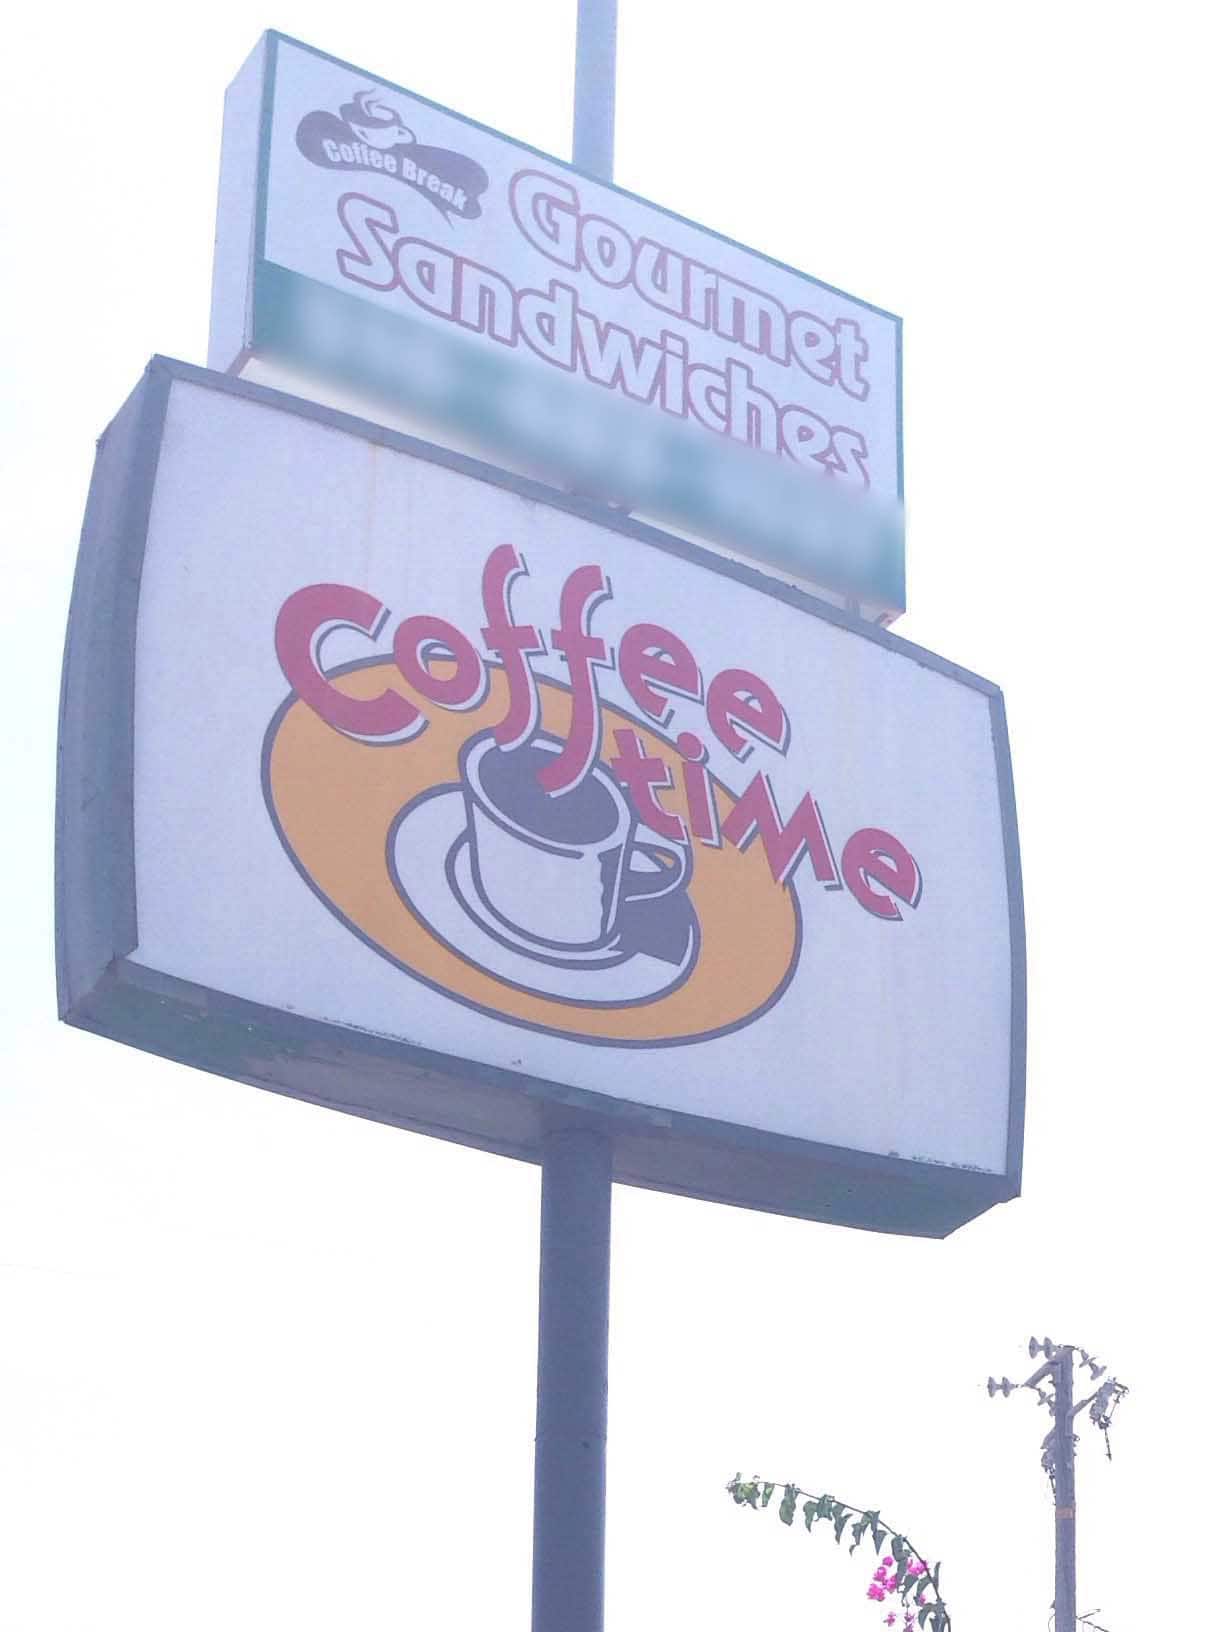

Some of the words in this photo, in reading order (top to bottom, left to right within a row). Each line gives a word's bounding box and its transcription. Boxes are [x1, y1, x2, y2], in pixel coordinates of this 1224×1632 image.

[322, 138, 398, 173] Coffee
[402, 157, 468, 211] Break
[509, 168, 869, 401] Gourmet
[337, 192, 870, 490] Sandwiches
